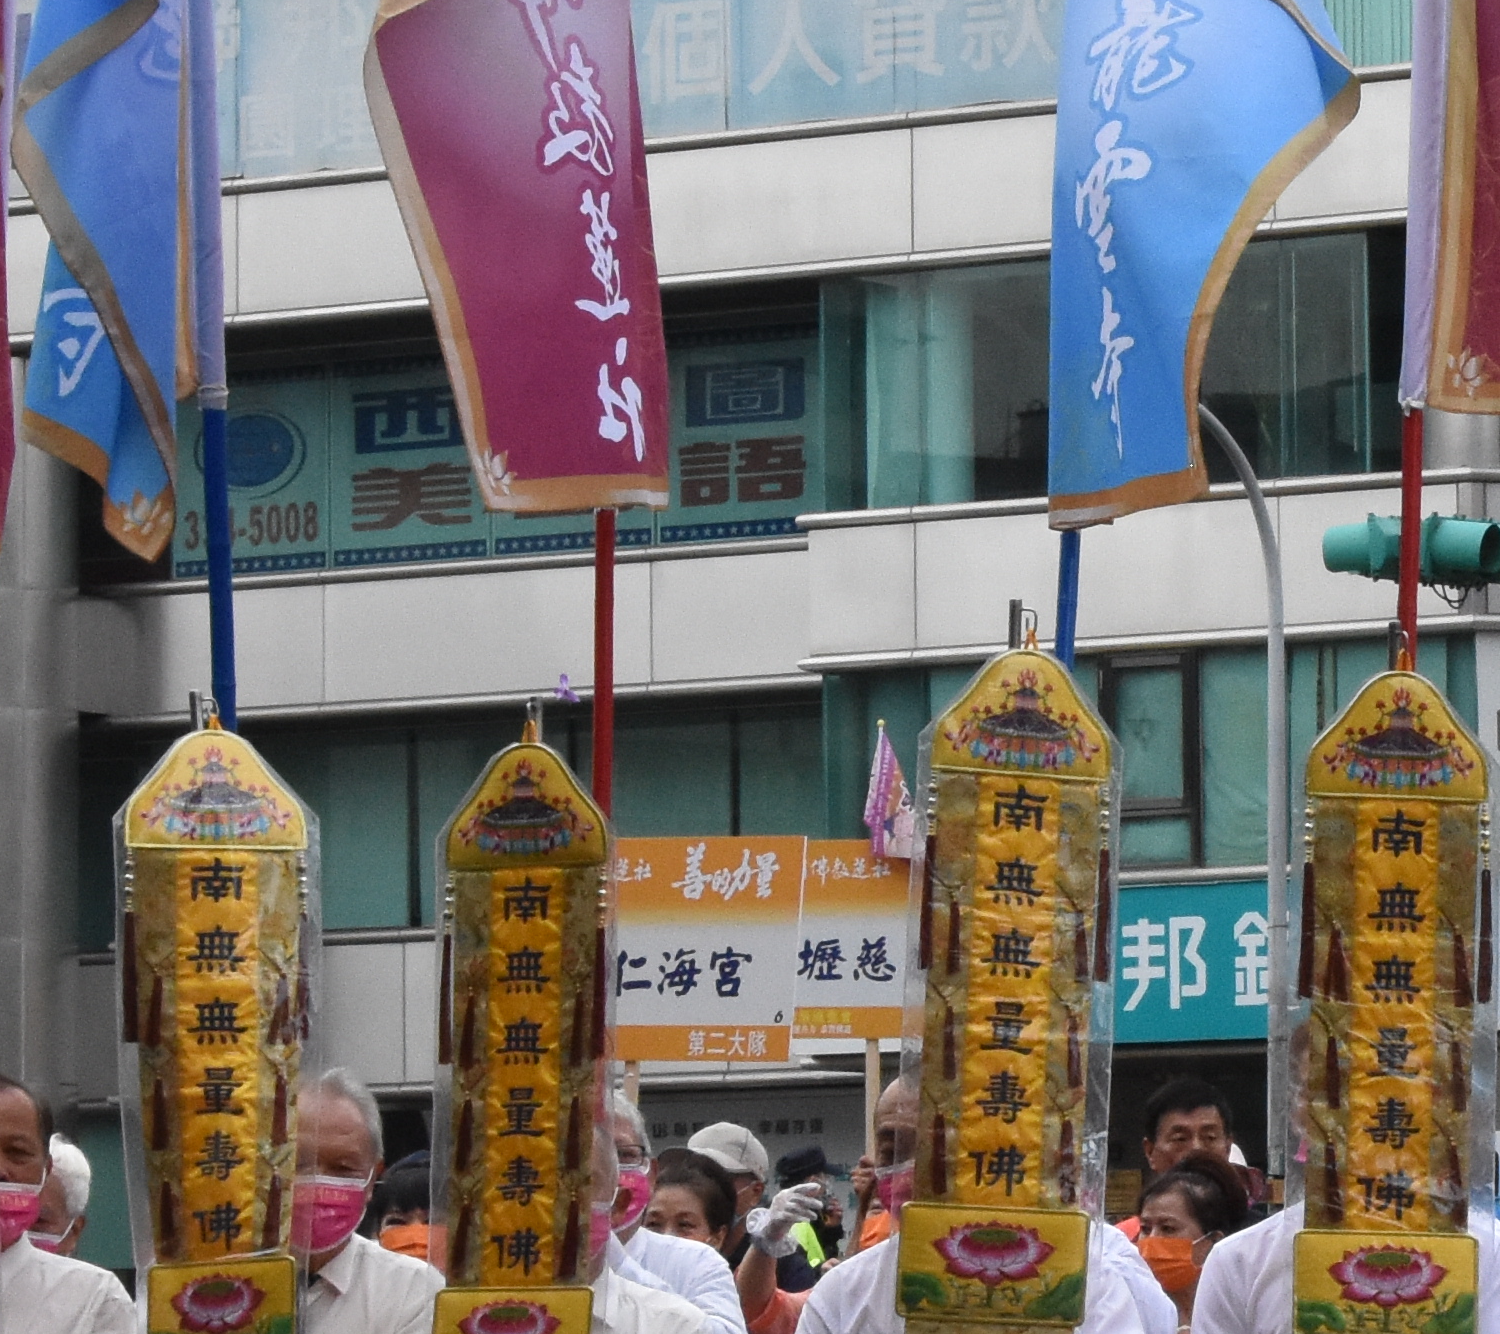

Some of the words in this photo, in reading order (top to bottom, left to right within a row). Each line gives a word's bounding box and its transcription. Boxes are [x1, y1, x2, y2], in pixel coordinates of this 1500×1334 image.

[186, 856, 250, 1251] 南無無量壽佛
[491, 876, 551, 1276] 南無無量壽佛
[616, 946, 753, 998] 仁海宮
[687, 1030, 768, 1057] 第二大隊
[968, 783, 1047, 1197] 南無無量壽佛
[1356, 808, 1425, 1219] 南無無量壽佛
